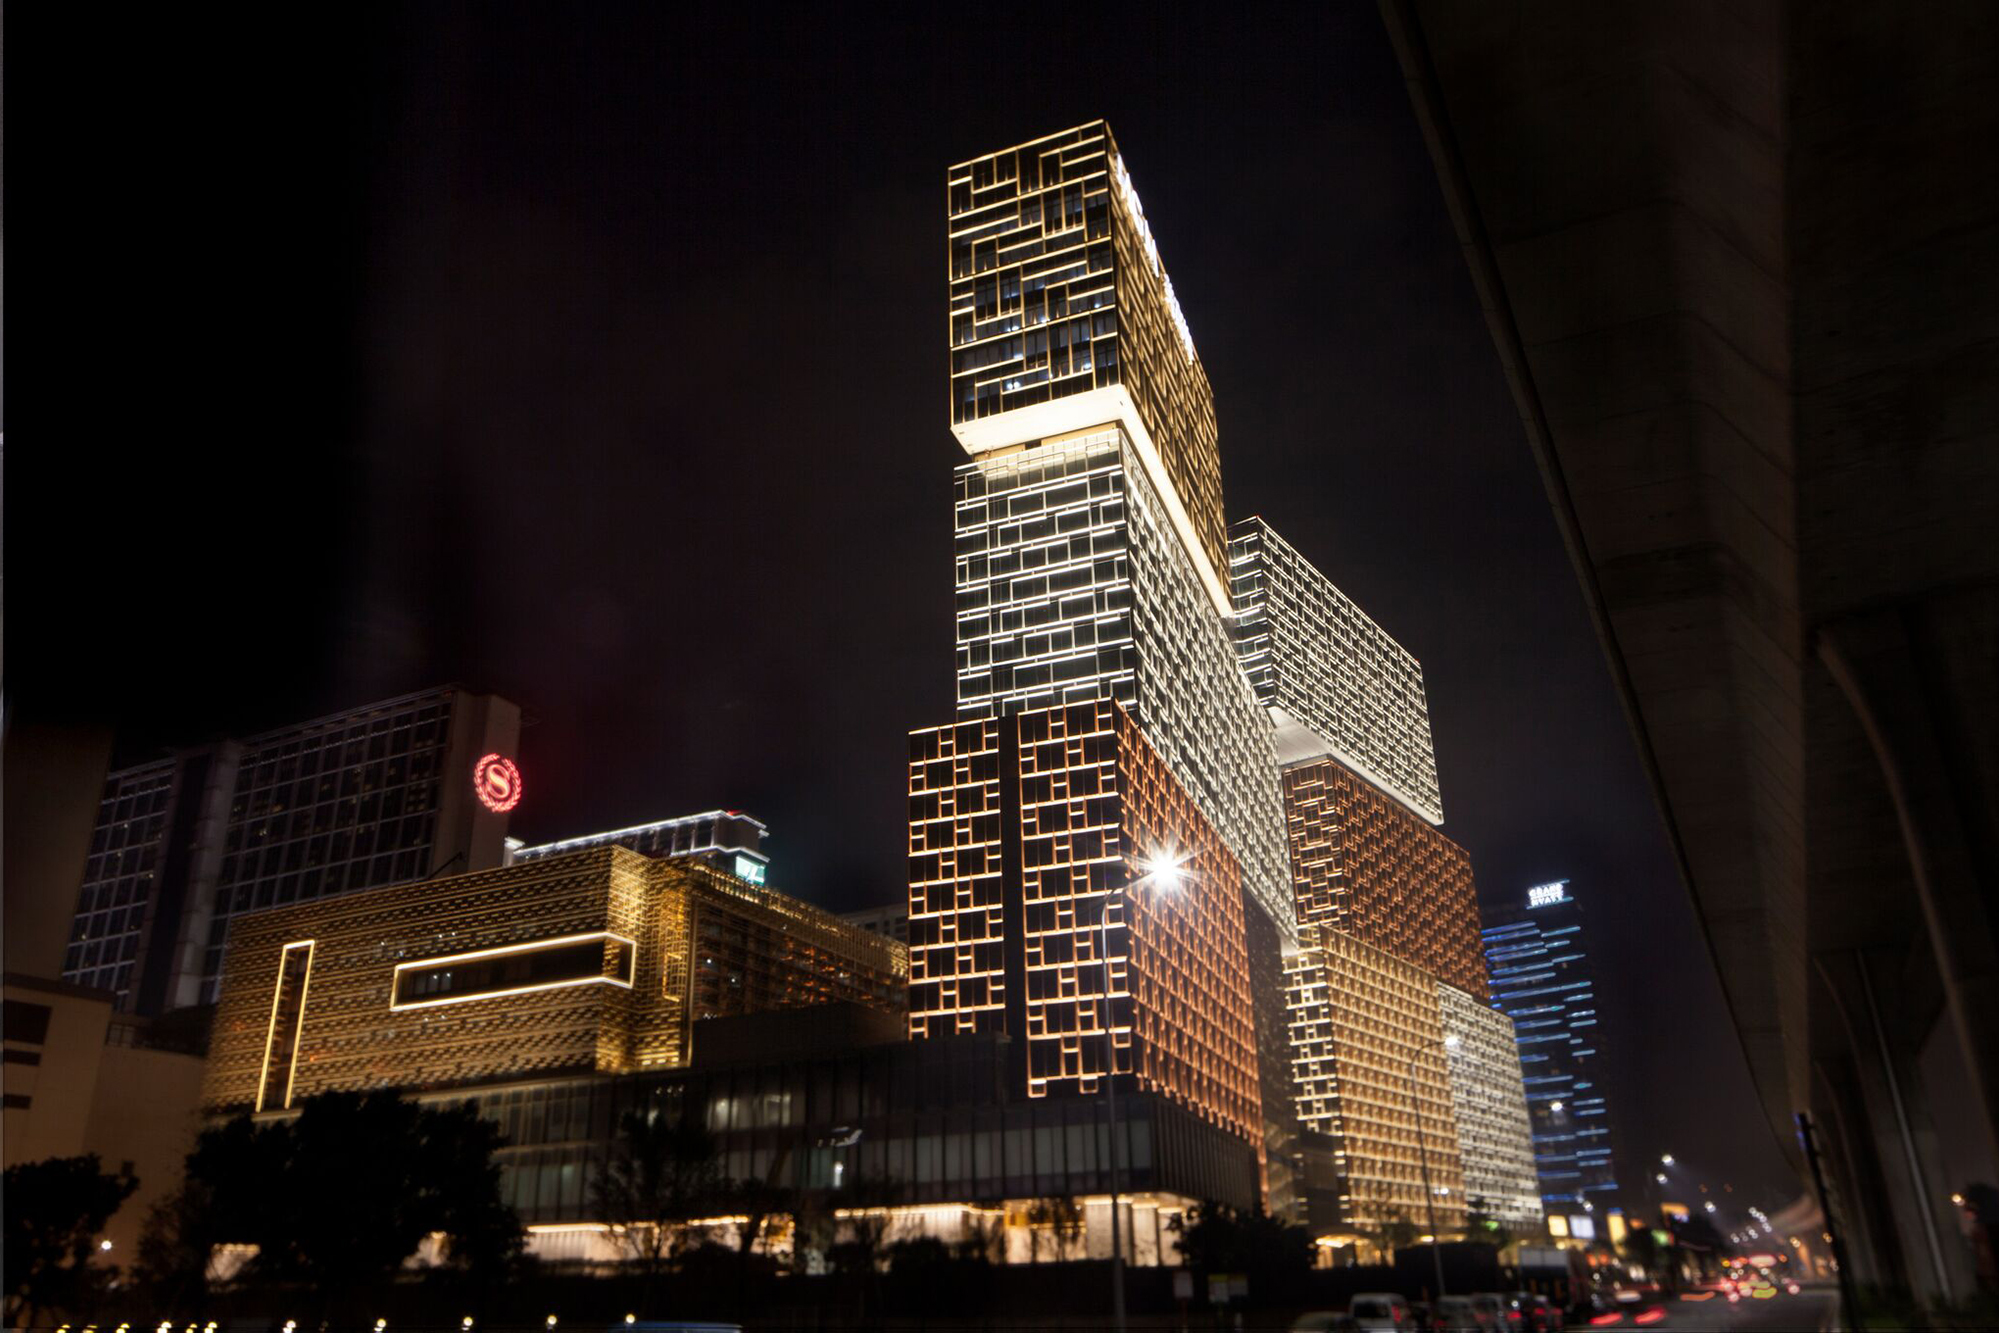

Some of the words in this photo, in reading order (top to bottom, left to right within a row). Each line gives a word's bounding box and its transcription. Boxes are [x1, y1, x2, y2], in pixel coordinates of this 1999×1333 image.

[486, 764, 511, 799] S
[1529, 883, 1563, 897] GRAND
[1530, 892, 1563, 907] HYATT
